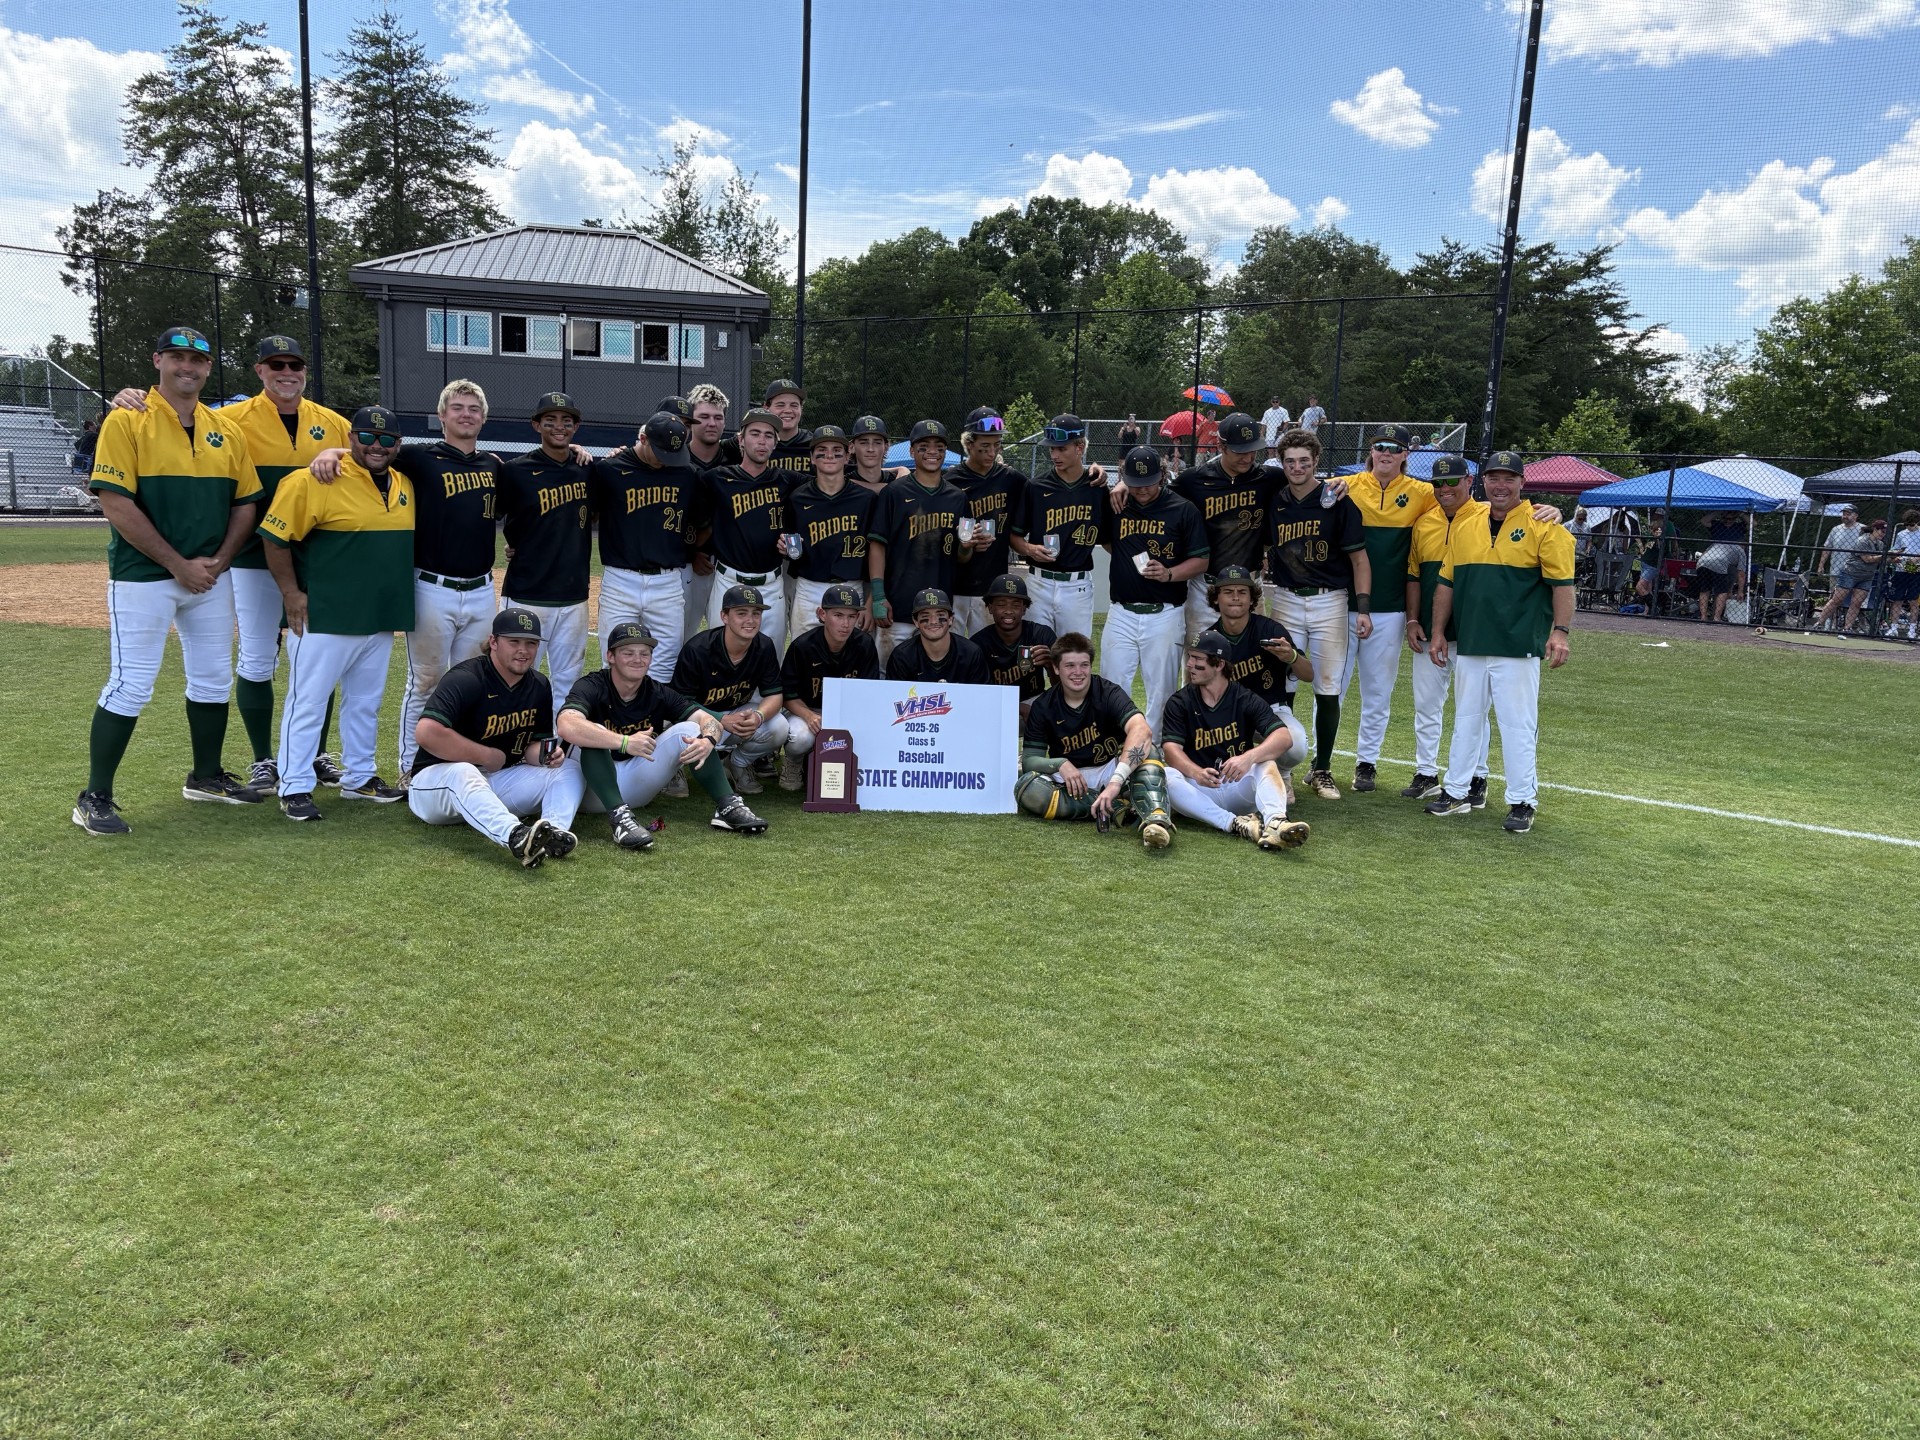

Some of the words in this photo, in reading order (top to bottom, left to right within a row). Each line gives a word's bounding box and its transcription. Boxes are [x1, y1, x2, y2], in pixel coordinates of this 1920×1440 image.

[94, 464, 124, 480] DCATS
[442, 471, 495, 498] BRIDGE
[538, 482, 587, 515] BRIDGE
[626, 487, 679, 514] BRIDGE
[732, 488, 781, 518] BRIDGE
[1205, 490, 1256, 519] BRIDGE
[579, 506, 587, 528] 9
[664, 507, 683, 532] 21
[909, 513, 955, 540] BRIDGE
[998, 513, 1008, 534] 7
[1046, 505, 1092, 531] BRIDGE
[1238, 509, 1263, 530] 32
[808, 516, 858, 546] BRIDGE
[1072, 524, 1098, 546] 40
[1120, 518, 1165, 540] BRIDGE
[1277, 520, 1320, 546] BRIDGE
[842, 535, 866, 557] 12
[944, 534, 953, 554] 8
[1148, 540, 1174, 559] 34
[1304, 540, 1328, 561] 19
[1262, 670, 1273, 690] 3
[894, 692, 951, 717] VHSL
[482, 709, 538, 740] BRIDGE
[905, 723, 939, 733] 2025-26
[908, 737, 929, 746] Class
[930, 738, 935, 746] 5
[1195, 722, 1238, 751] BRIDGE
[898, 751, 944, 764] Baseball
[1092, 739, 1119, 764] 20
[857, 769, 897, 788] STATE
[902, 770, 985, 790] CHAMPIONS
